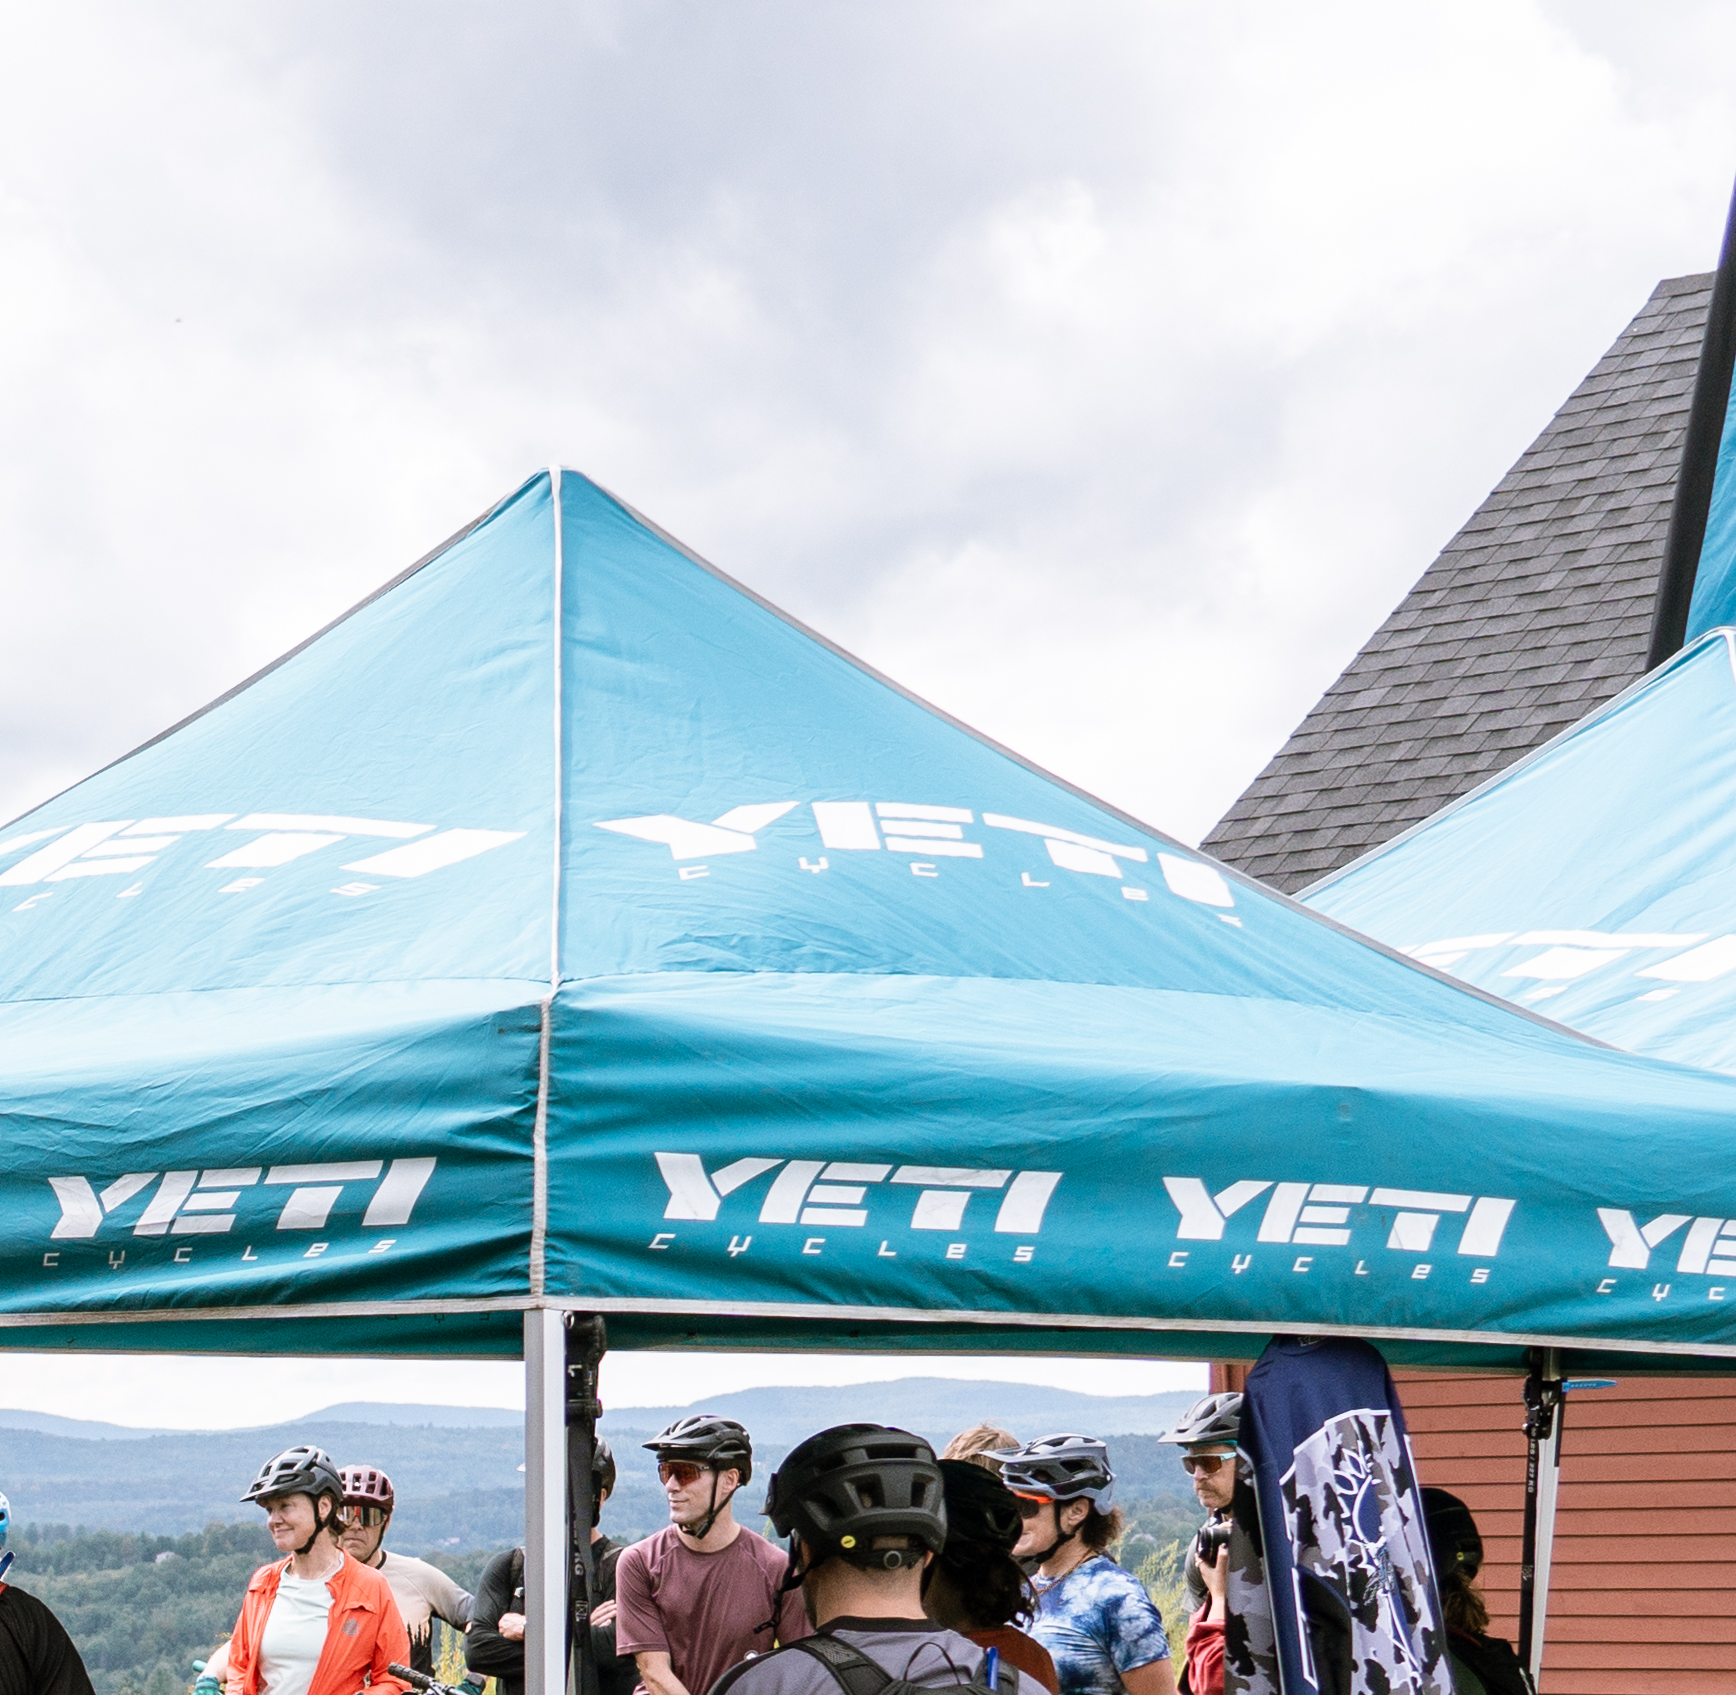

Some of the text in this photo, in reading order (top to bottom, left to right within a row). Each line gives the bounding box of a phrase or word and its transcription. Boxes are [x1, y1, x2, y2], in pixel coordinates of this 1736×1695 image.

[592, 800, 1236, 908] YETI
[46, 1151, 1736, 1276] YETI YETI YETI YE
